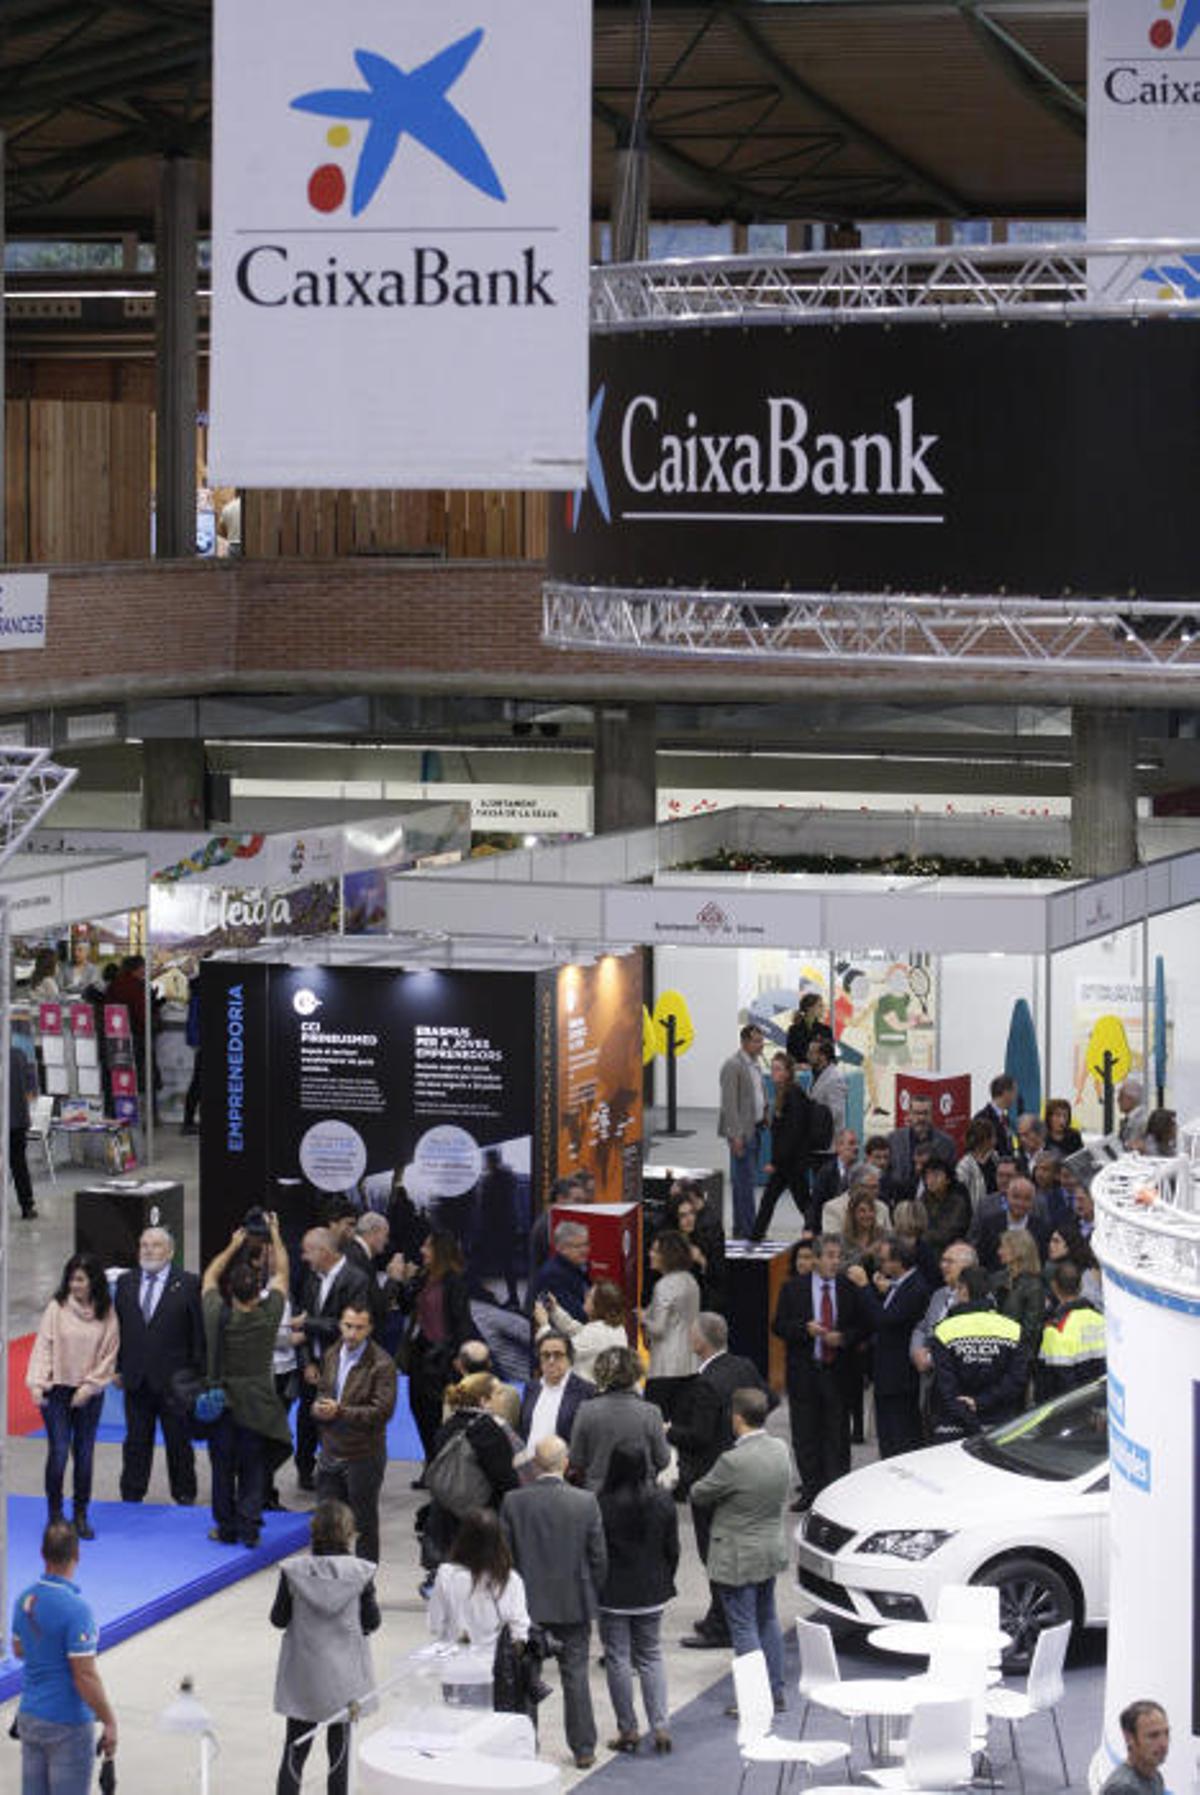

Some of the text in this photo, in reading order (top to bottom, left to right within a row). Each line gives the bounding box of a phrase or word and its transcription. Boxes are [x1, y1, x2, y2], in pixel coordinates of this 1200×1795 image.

[236, 245, 557, 308] CaixaBank
[621, 395, 944, 495] CaixaBank
[227, 984, 245, 1152] EMPRENEDORIA
[452, 1040, 490, 1050] JOVES
